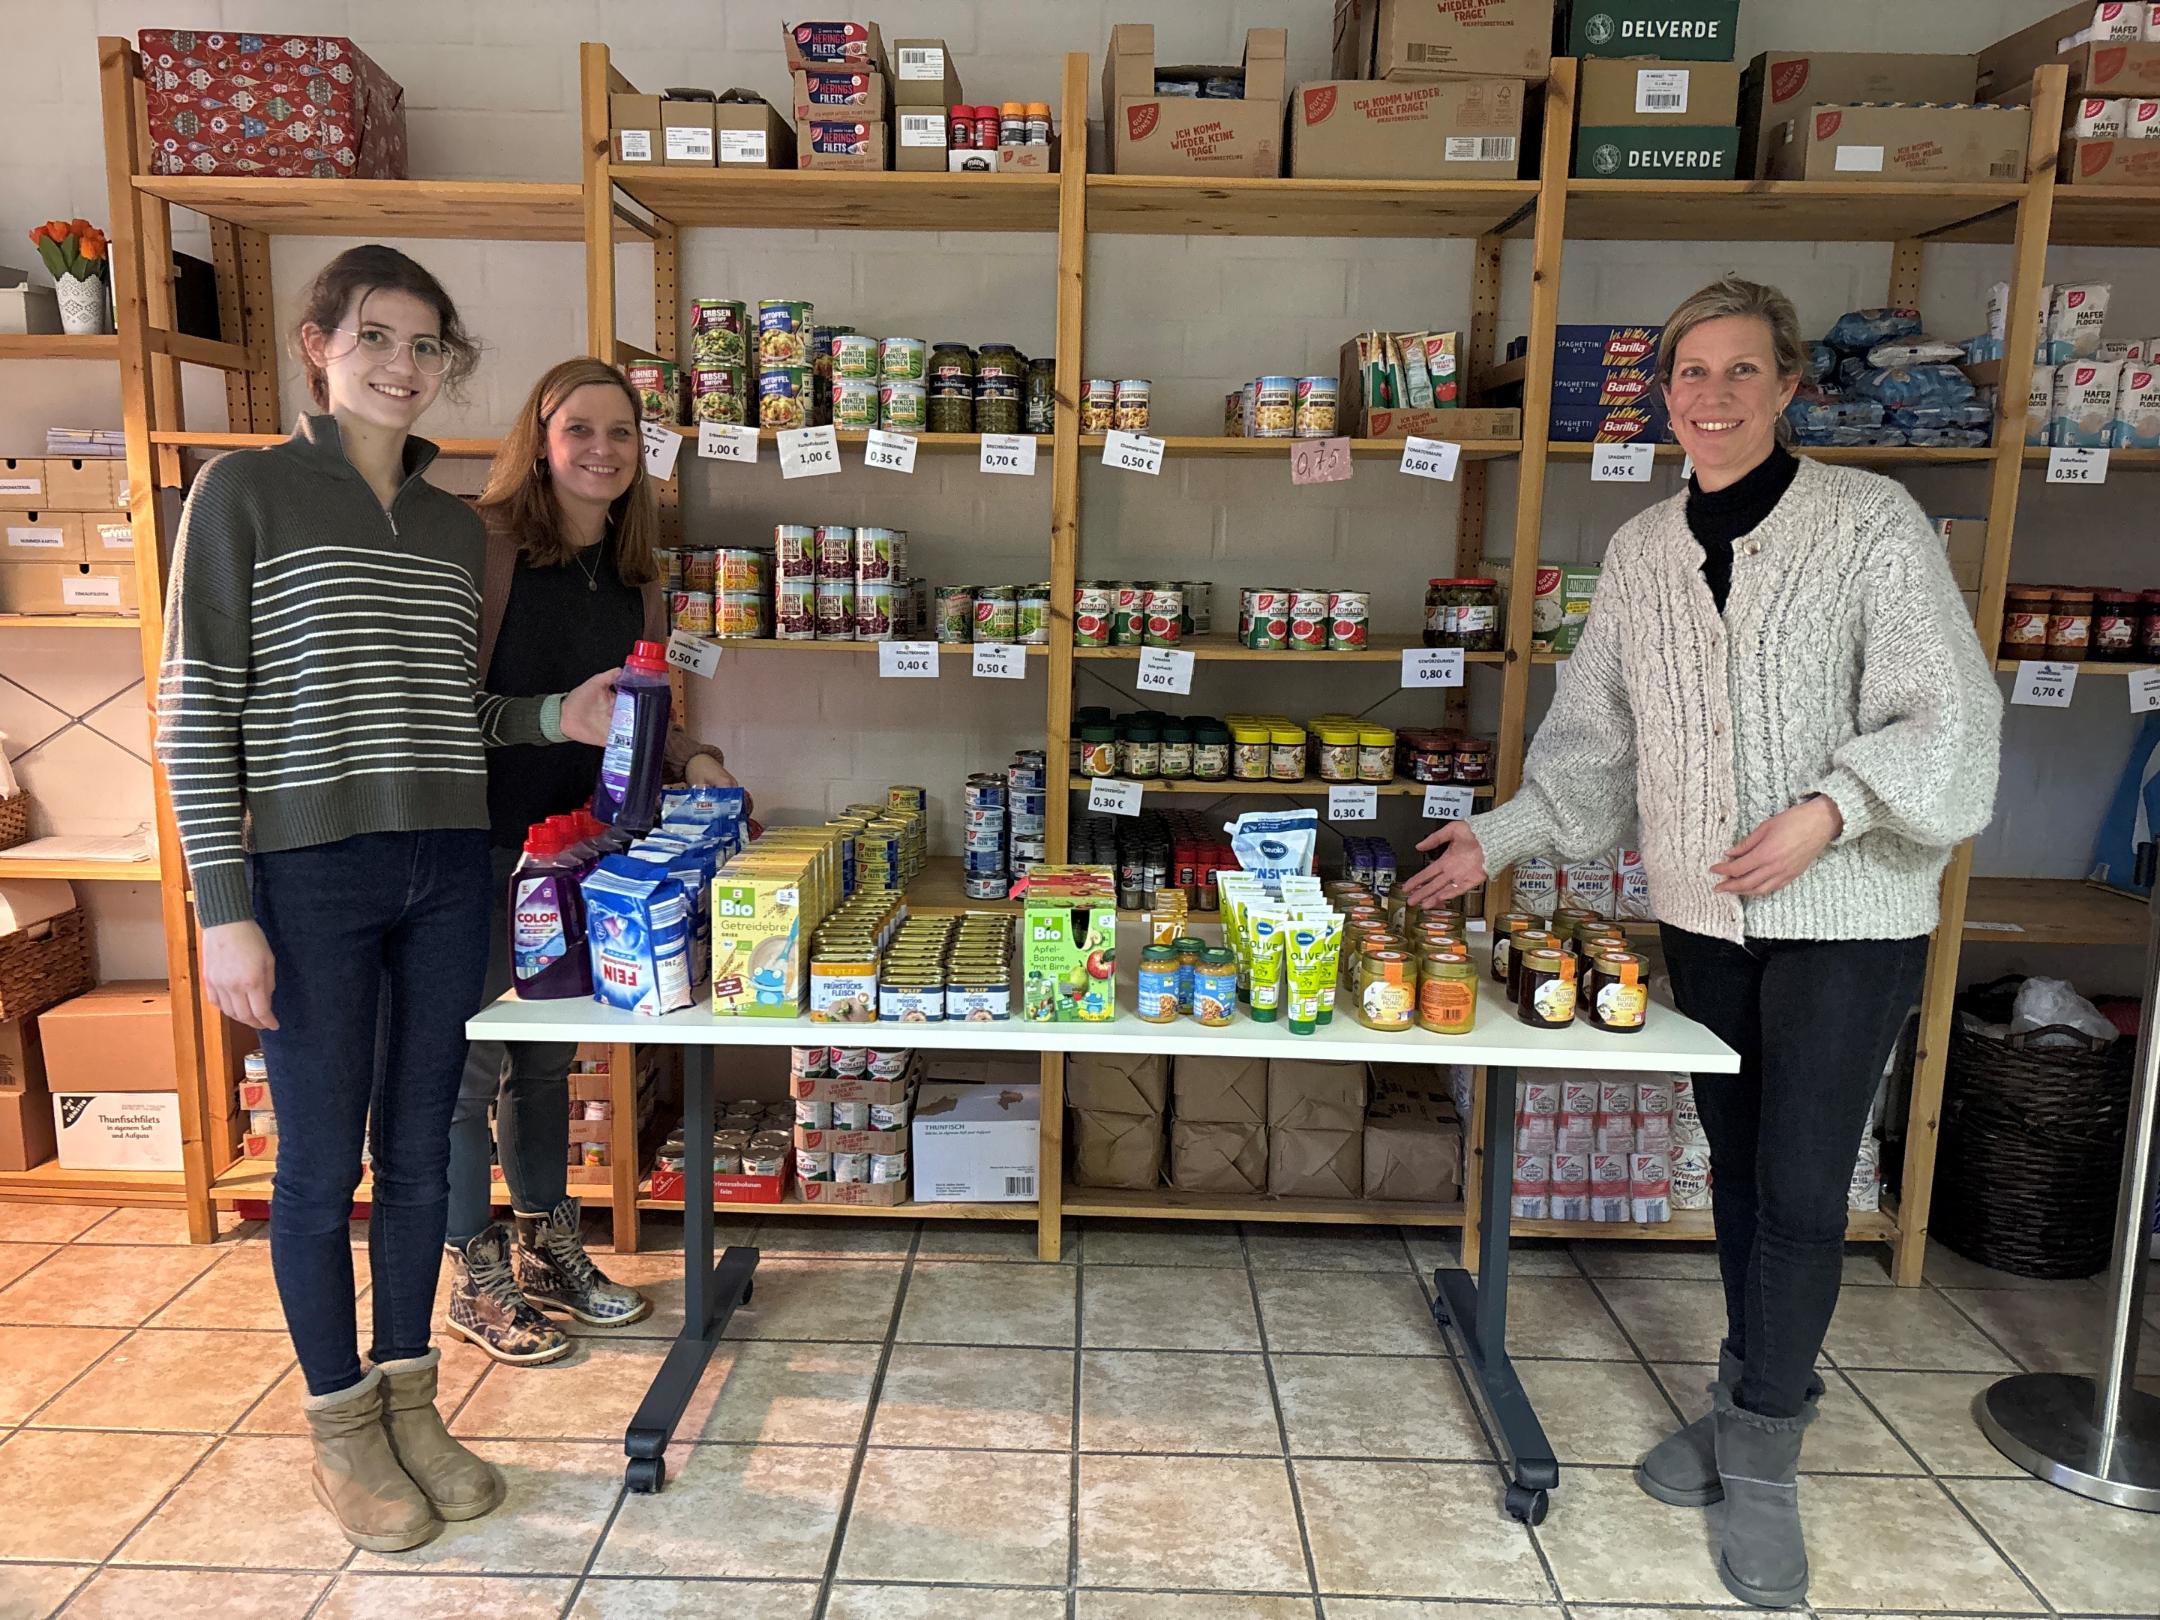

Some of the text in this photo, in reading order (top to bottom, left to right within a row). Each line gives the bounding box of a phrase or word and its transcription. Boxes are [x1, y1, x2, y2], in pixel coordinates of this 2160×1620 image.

[1454, 9, 1486, 21] FRAGE!
[1621, 20, 1718, 38] DELVERDE
[2111, 26, 2137, 34] HAFER
[812, 34, 846, 44] HERINGS
[812, 44, 836, 54] FILETS
[820, 84, 853, 93] HERINGS
[820, 94, 843, 104] FILETS
[1353, 101, 1369, 111] ICH
[1372, 94, 1402, 107] KOMM
[1366, 101, 1428, 119] KEINE FRAGE!
[1175, 121, 1221, 140] ICH KOMM
[2094, 123, 2119, 131] HAFER
[823, 133, 856, 143] HERINGS
[1208, 130, 1235, 144] KEINE
[823, 144, 847, 153] FILETS
[1186, 145, 1217, 157] FRAGE!
[1628, 150, 1722, 168] DELVERDE
[703, 309, 731, 318] ERBSEN
[2077, 311, 2104, 319] HAFER
[1557, 341, 1601, 349] SPAGHETTINI
[1609, 342, 1646, 353] Barilla
[841, 350, 865, 358] PRINZESS
[886, 352, 907, 360] PRINZESS
[841, 357, 865, 365] BOHNEN
[886, 359, 908, 367] BOHNEN
[700, 372, 728, 381] ERBSEN
[1554, 380, 1599, 389] SPAGHETTINI
[1606, 382, 1642, 393] Barilla
[2083, 390, 2111, 399] HAFER
[841, 397, 865, 405] PRINZESS
[891, 398, 915, 407] PRINZESS
[841, 404, 865, 412] BOHNEN
[892, 405, 915, 413] BOHNEN
[1555, 420, 1592, 428] SPAGHETTI
[1603, 421, 1640, 432] Barilla
[652, 448, 660, 458] €
[707, 443, 740, 455] 1,00 €
[800, 450, 832, 465] 1,00 €
[870, 451, 903, 467] 0,35 €
[985, 454, 1018, 467] 0,70 €
[1121, 454, 1154, 470] 0,50 €
[1297, 448, 1340, 478] 0,75
[1405, 458, 1439, 473] 0,60 €
[1602, 465, 1635, 477] 0,45 €
[2055, 469, 2088, 480] 0,35 €
[824, 548, 847, 557] BOHNEN
[694, 567, 712, 576] MAIS
[727, 566, 746, 575] MAIS
[1567, 579, 1599, 592] LANGKOR
[689, 608, 708, 617] MAIS
[724, 609, 742, 618] MAIS
[669, 649, 700, 668] 0,50 €
[897, 660, 929, 671] 0,40 €
[976, 663, 1008, 674] 0,50 €
[1420, 669, 1452, 679] 0,80 €
[1143, 673, 1175, 686] 0,40 €
[2031, 686, 2065, 698] 0,70 €
[1093, 797, 1124, 809] 0,30 €
[1333, 807, 1365, 819] 0,30 €
[1427, 806, 1460, 817] 0,30 €
[1514, 870, 1552, 880] Weizen
[1571, 871, 1610, 881] Weizen
[1519, 881, 1547, 889] MEHL
[1577, 882, 1605, 890] MEHL
[720, 899, 754, 917] Bio
[517, 913, 558, 923] COLOR
[721, 919, 790, 932] Getreidebrei
[1034, 926, 1062, 941] Bio
[1033, 945, 1061, 955] Apfel-
[1250, 940, 1278, 951] OLIVE
[1033, 954, 1065, 962] Banane
[1290, 952, 1320, 961] OLIVE
[1033, 962, 1070, 971] mit Birne
[603, 964, 638, 987] FEIN
[831, 989, 856, 997] FLEISCH
[97, 1114, 161, 1124] Thunfischfilets
[1672, 1170, 1705, 1182] Weizen
[1674, 1180, 1700, 1189] MEHL
